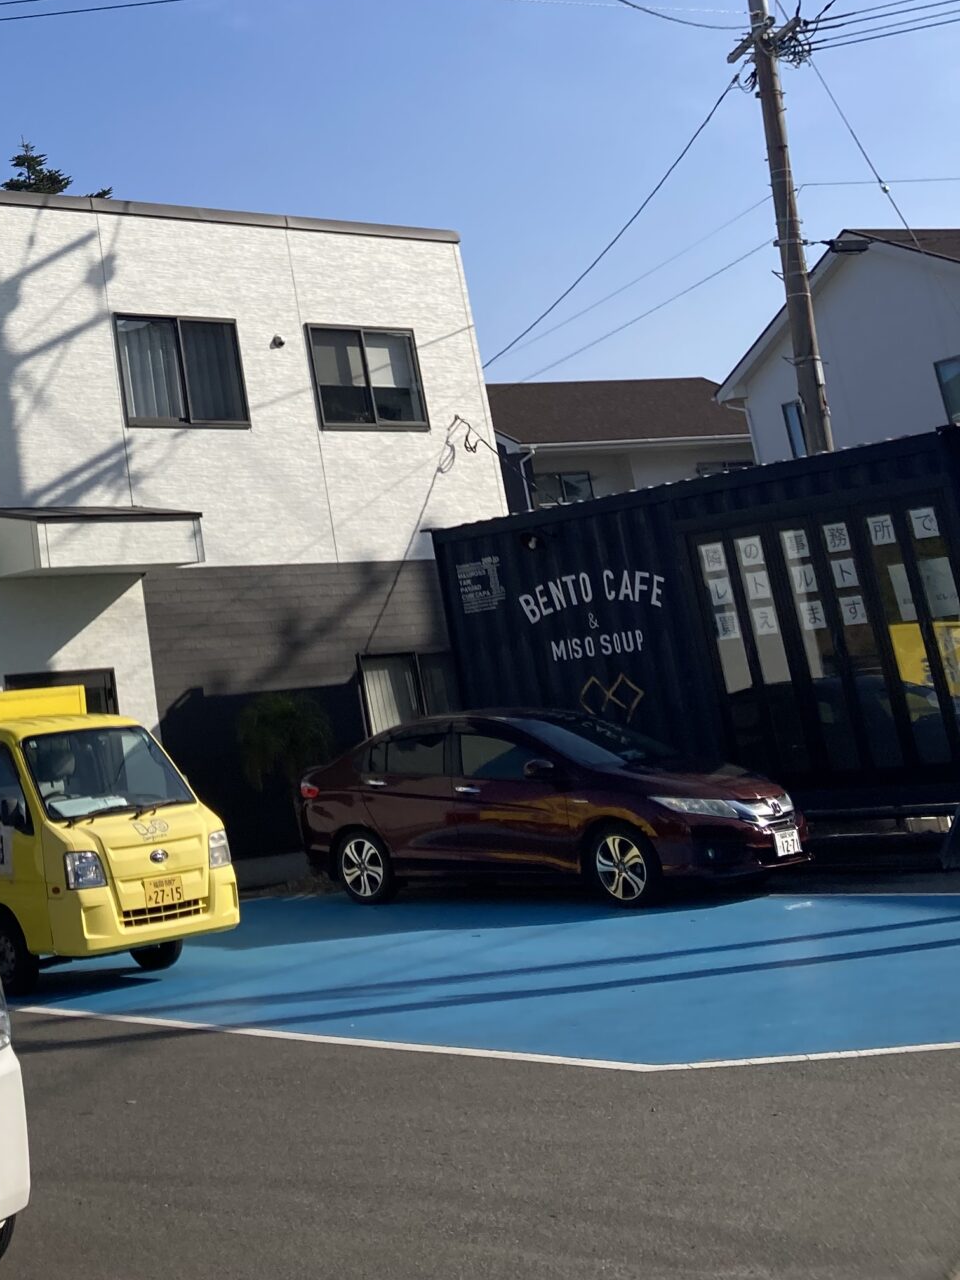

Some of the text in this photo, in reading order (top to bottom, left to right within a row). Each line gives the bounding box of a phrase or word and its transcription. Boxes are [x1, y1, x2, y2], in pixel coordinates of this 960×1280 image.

[519, 572, 593, 624] BENTO
[603, 569, 665, 608] CAFE
[588, 612, 599, 629] &
[551, 629, 643, 662] MISO SOUP
